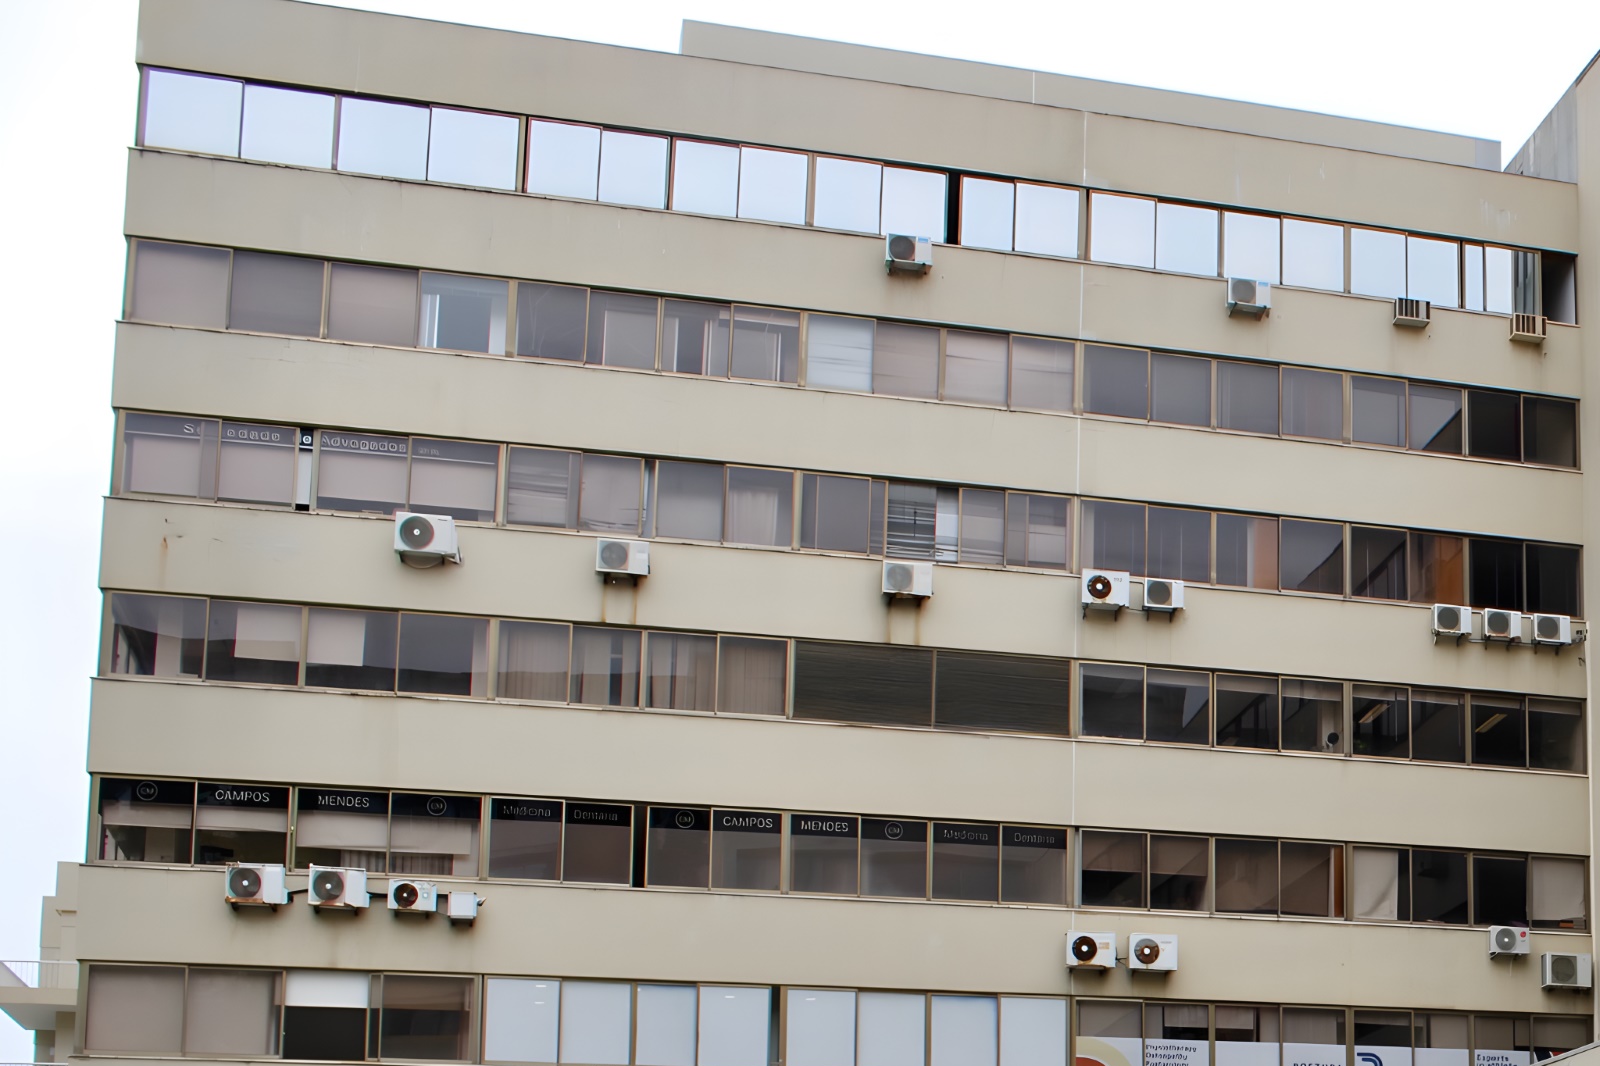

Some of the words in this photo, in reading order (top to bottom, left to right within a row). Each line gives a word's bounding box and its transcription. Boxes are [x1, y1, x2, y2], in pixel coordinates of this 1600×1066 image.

[214, 788, 270, 803] CAMPOS
[317, 794, 370, 810] MENDES
[722, 815, 774, 829] CAMPOS
[800, 820, 849, 832] MENDES
